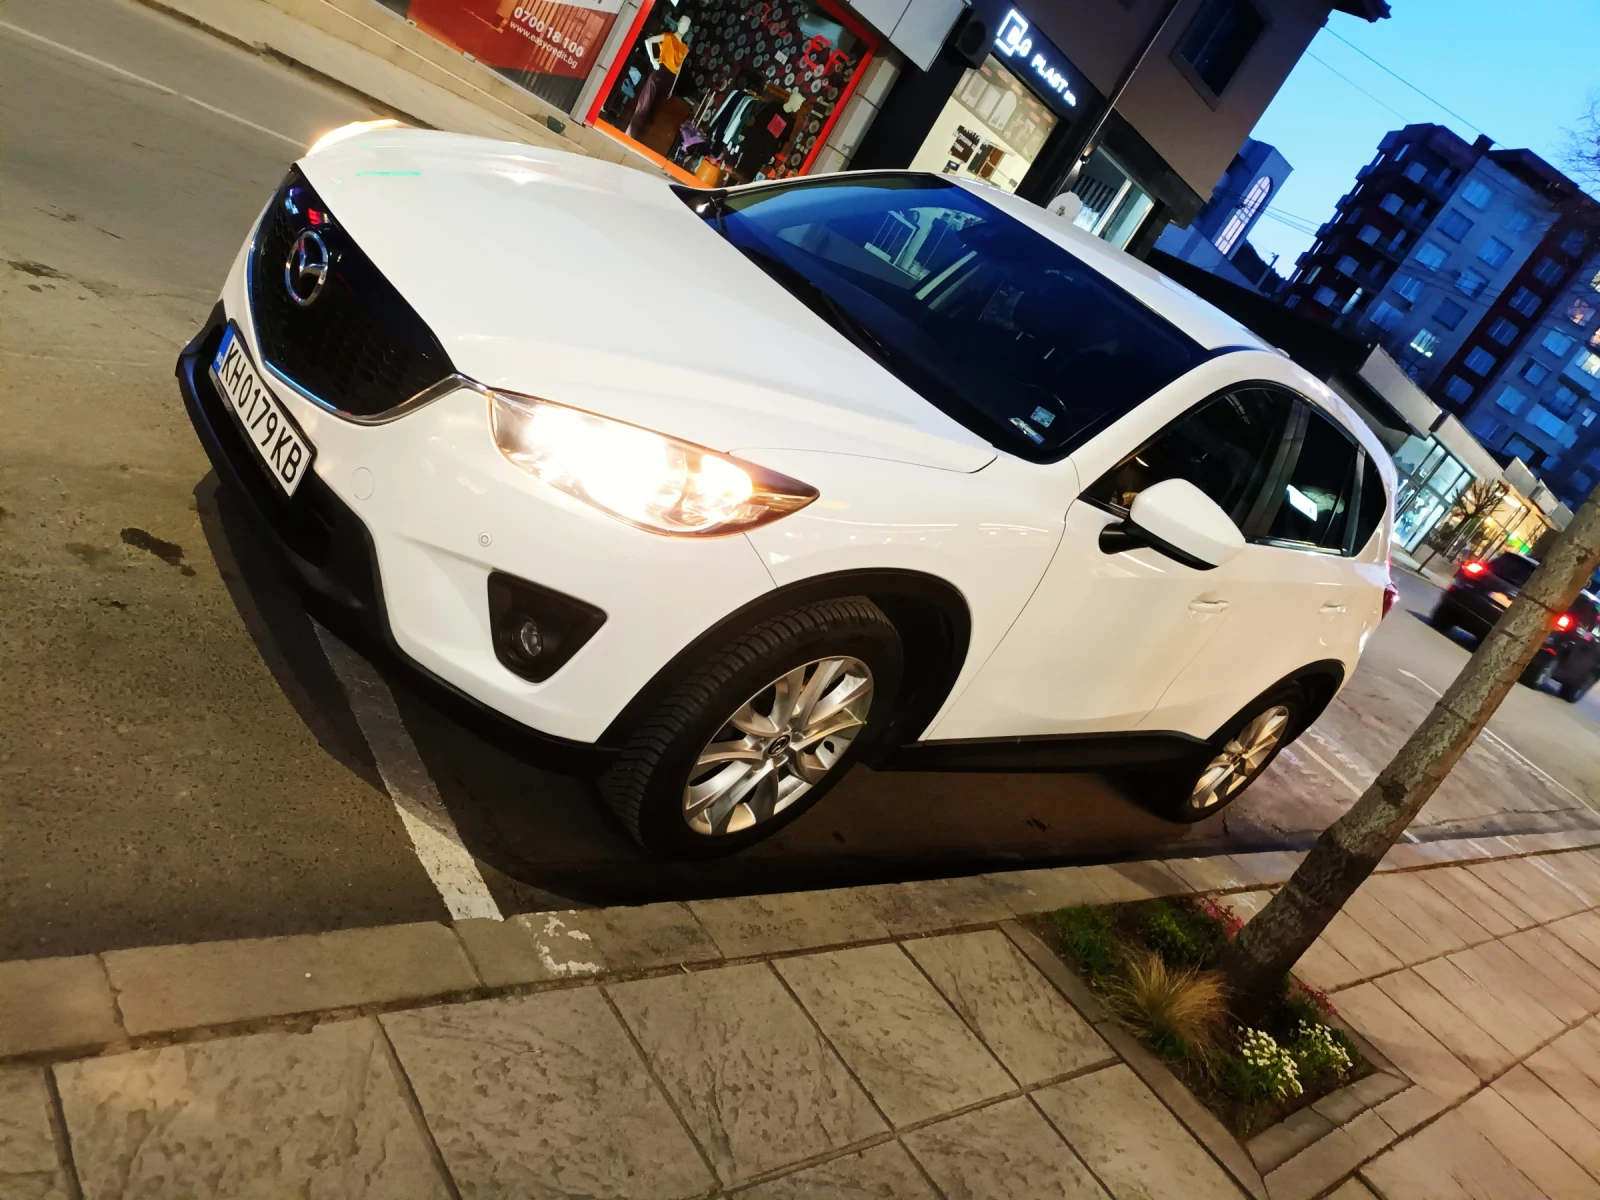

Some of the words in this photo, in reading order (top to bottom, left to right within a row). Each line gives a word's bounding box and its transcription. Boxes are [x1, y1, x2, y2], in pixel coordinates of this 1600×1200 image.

[509, 20, 578, 69] www.easycredit.bg
[513, 6, 545, 33] 0700
[546, 27, 562, 43] 18
[562, 37, 584, 58] 100
[1031, 53, 1069, 93] PLAST
[221, 342, 302, 484] KH0179KB
